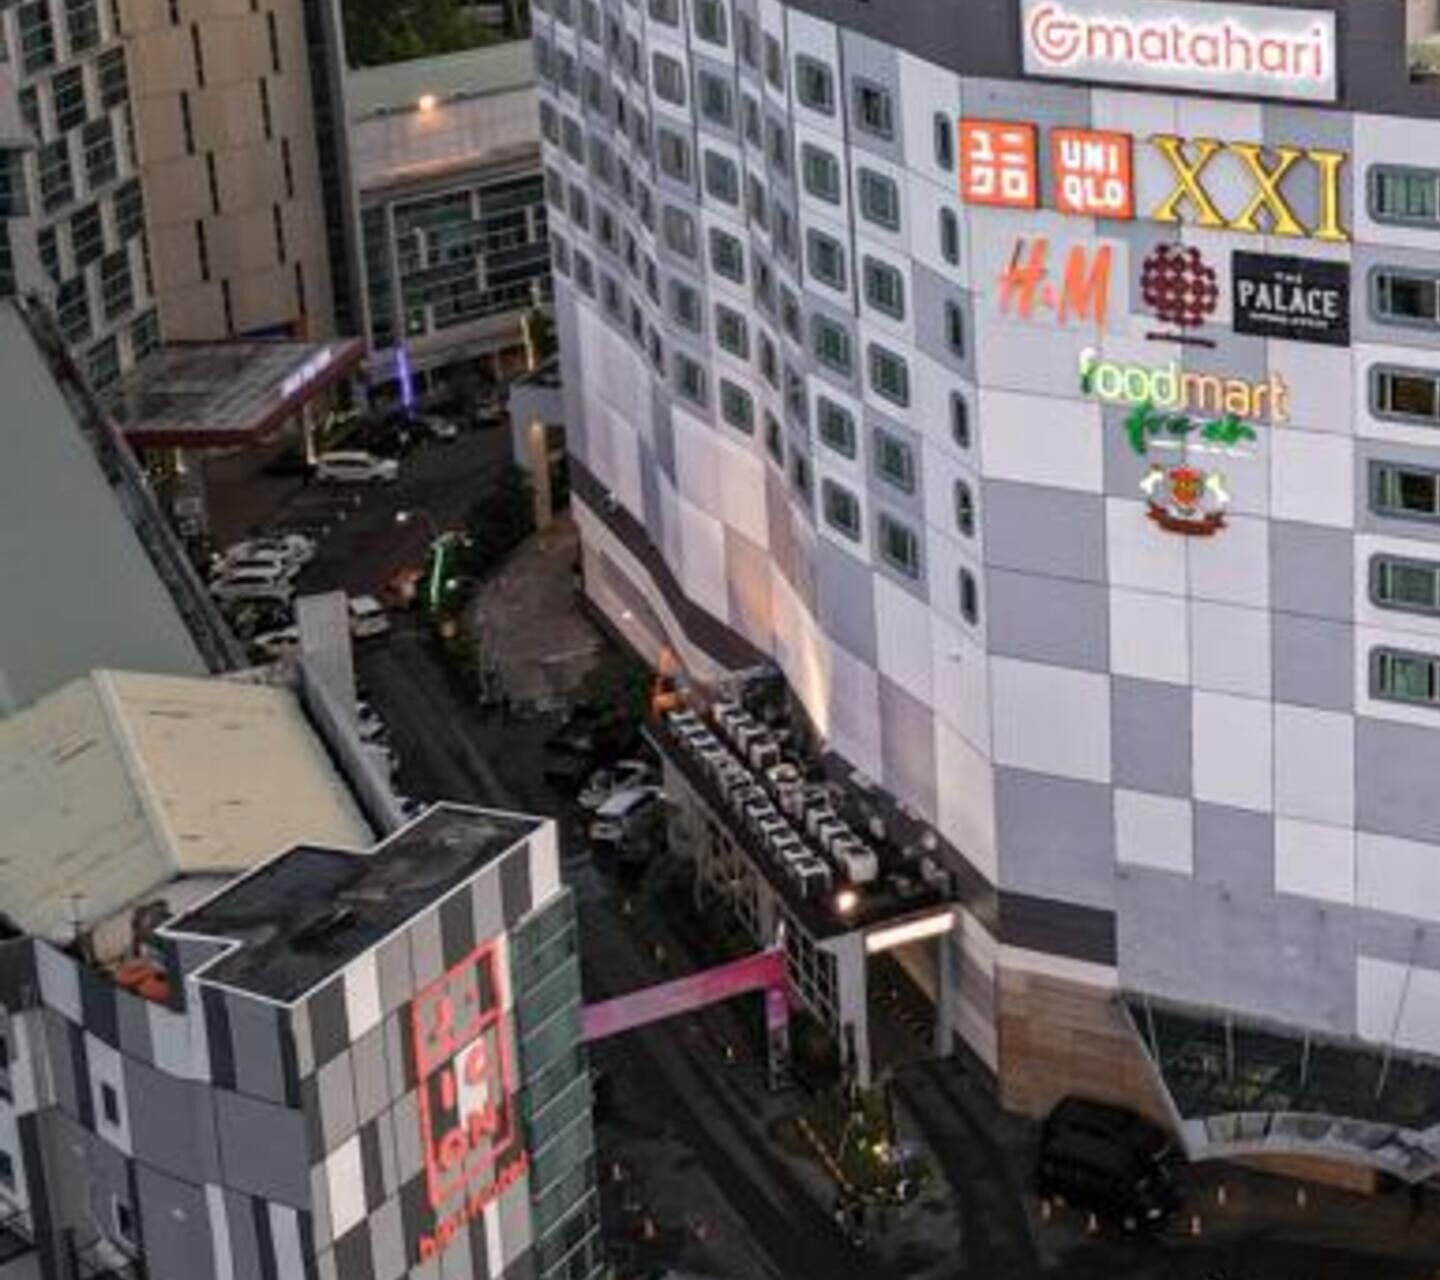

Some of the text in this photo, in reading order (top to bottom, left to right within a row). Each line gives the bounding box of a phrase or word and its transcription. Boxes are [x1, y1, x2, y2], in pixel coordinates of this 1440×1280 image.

[1086, 23, 1322, 76] matahari
[1061, 138, 1118, 174] UNI
[1064, 174, 1124, 209] QLO
[1149, 133, 1354, 244] XXI
[1237, 279, 1339, 319] PALACE
[1078, 346, 1289, 423] foodmart
